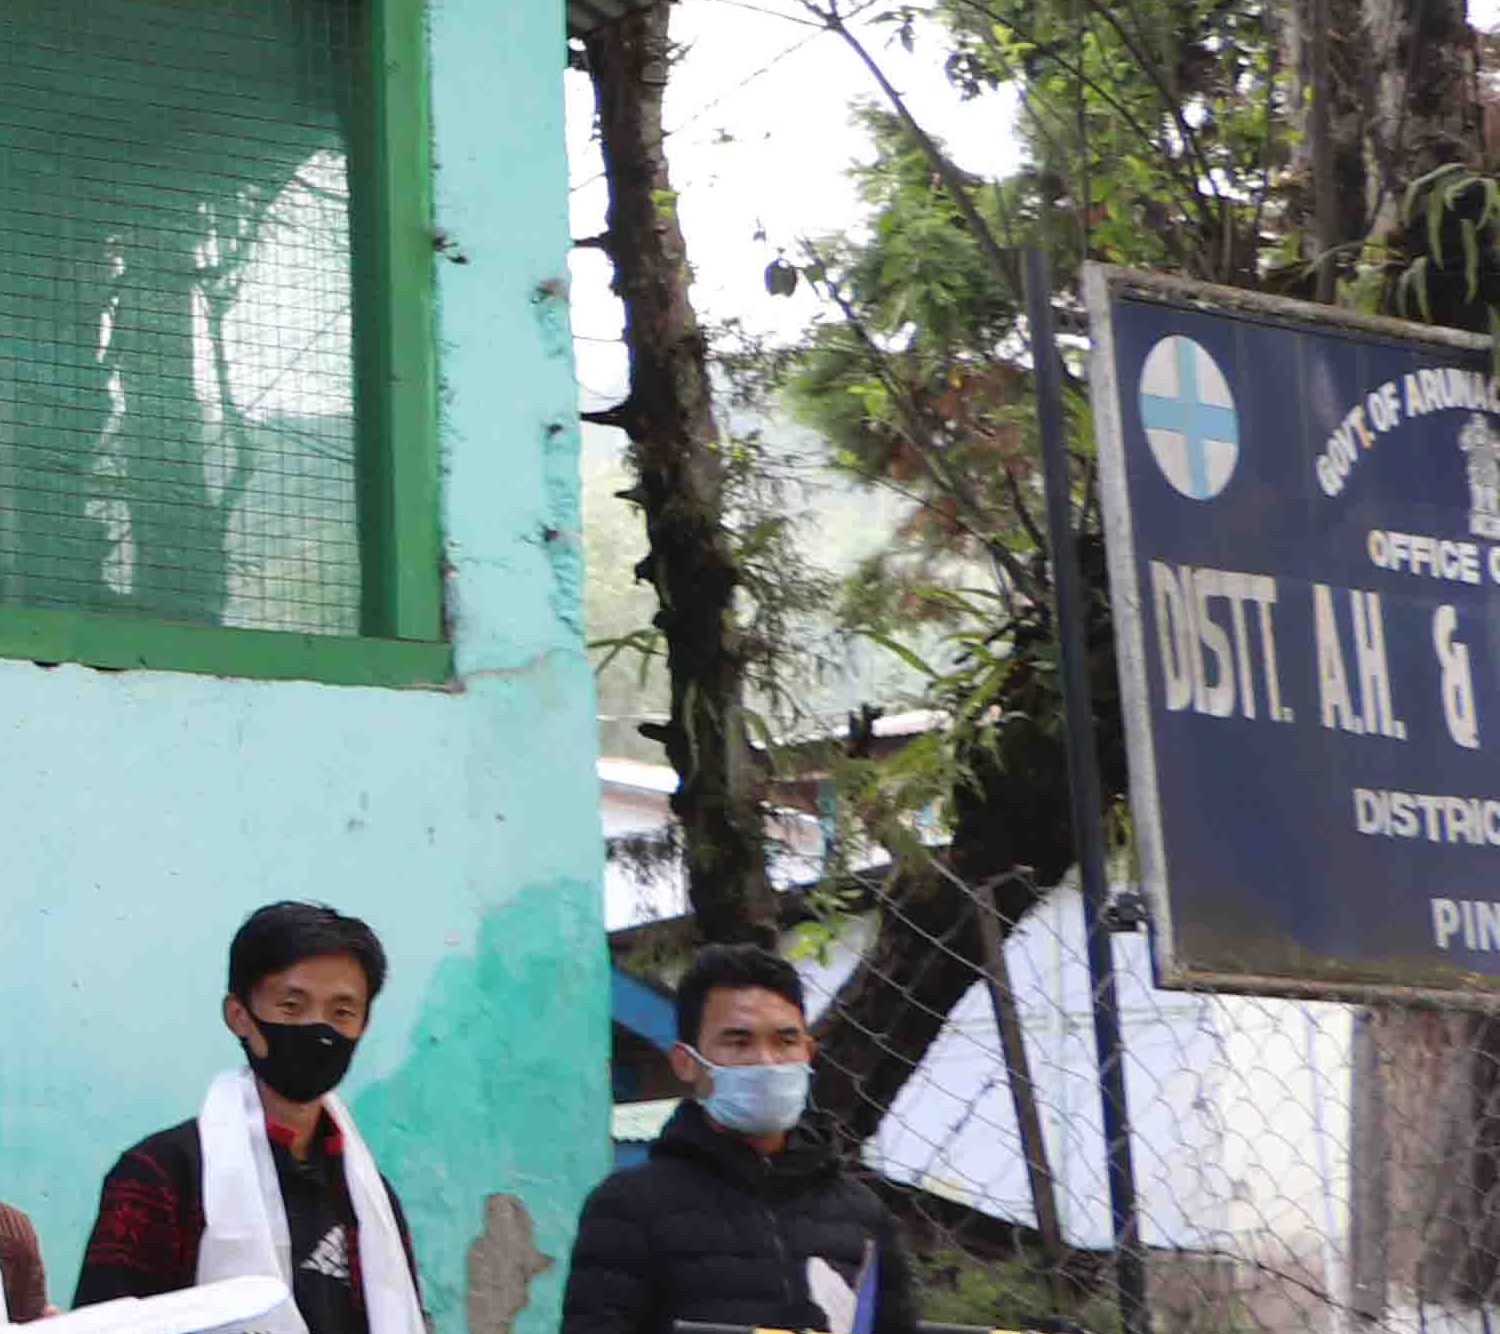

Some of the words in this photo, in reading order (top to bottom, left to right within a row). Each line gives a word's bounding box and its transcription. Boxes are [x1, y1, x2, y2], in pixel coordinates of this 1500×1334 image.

[1367, 379, 1400, 432] OF
[1368, 529, 1481, 585] OFFICE
[1149, 559, 1294, 723] DISTT.
[1312, 582, 1407, 741] A.H.
[1431, 604, 1480, 750] &
